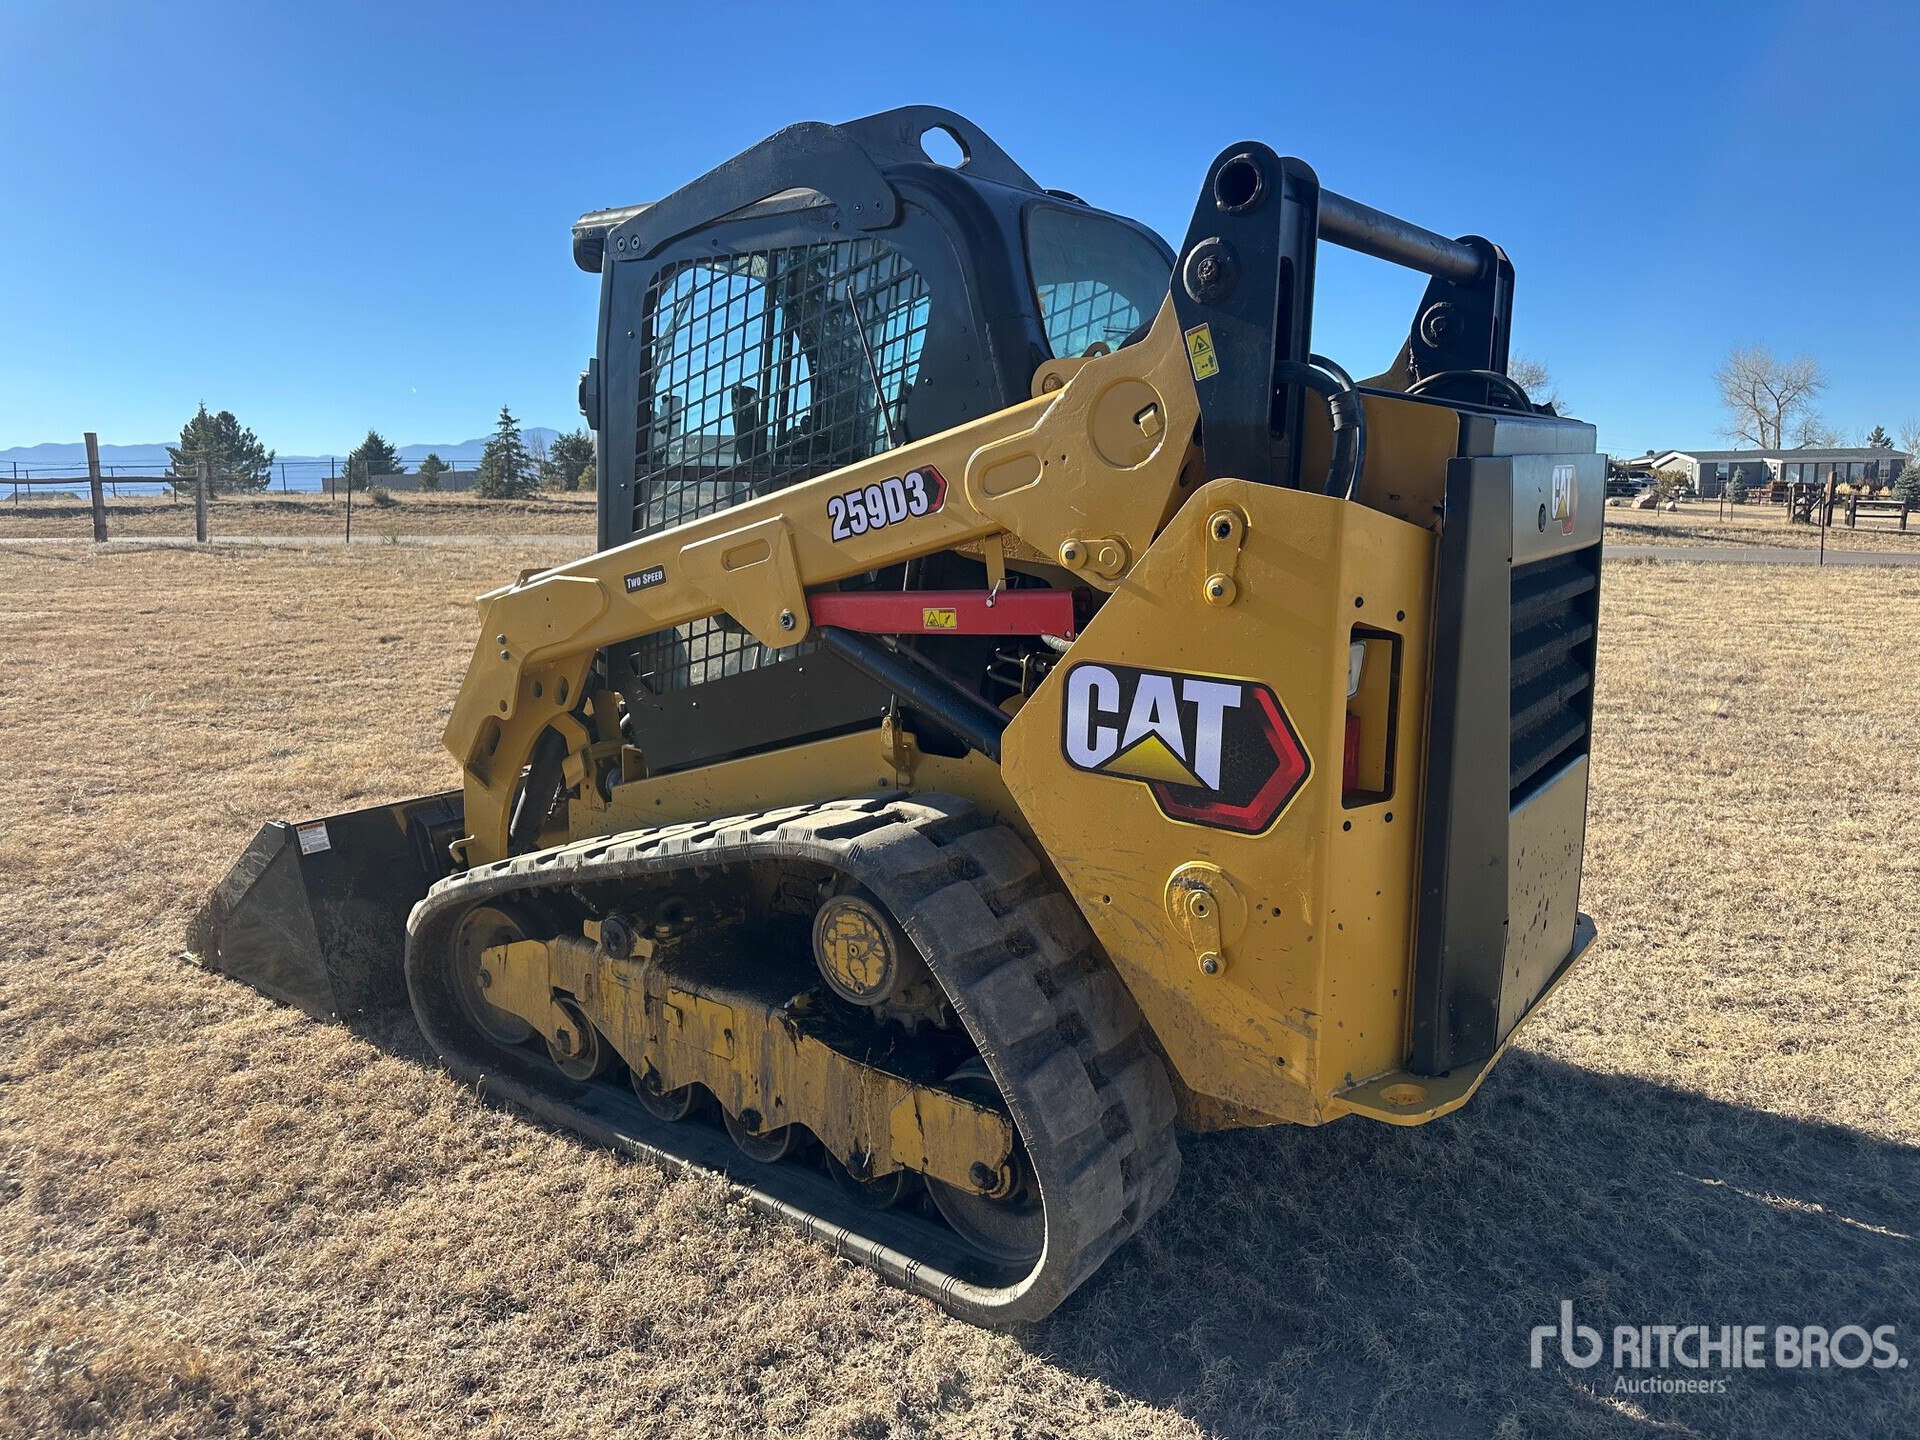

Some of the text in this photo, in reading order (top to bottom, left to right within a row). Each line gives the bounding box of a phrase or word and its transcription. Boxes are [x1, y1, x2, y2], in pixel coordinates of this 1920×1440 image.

[828, 471, 929, 543] 259D3
[1551, 468, 1573, 519] CAT
[626, 570, 663, 589] TWO SPEED
[1066, 665, 1242, 791] CAT
